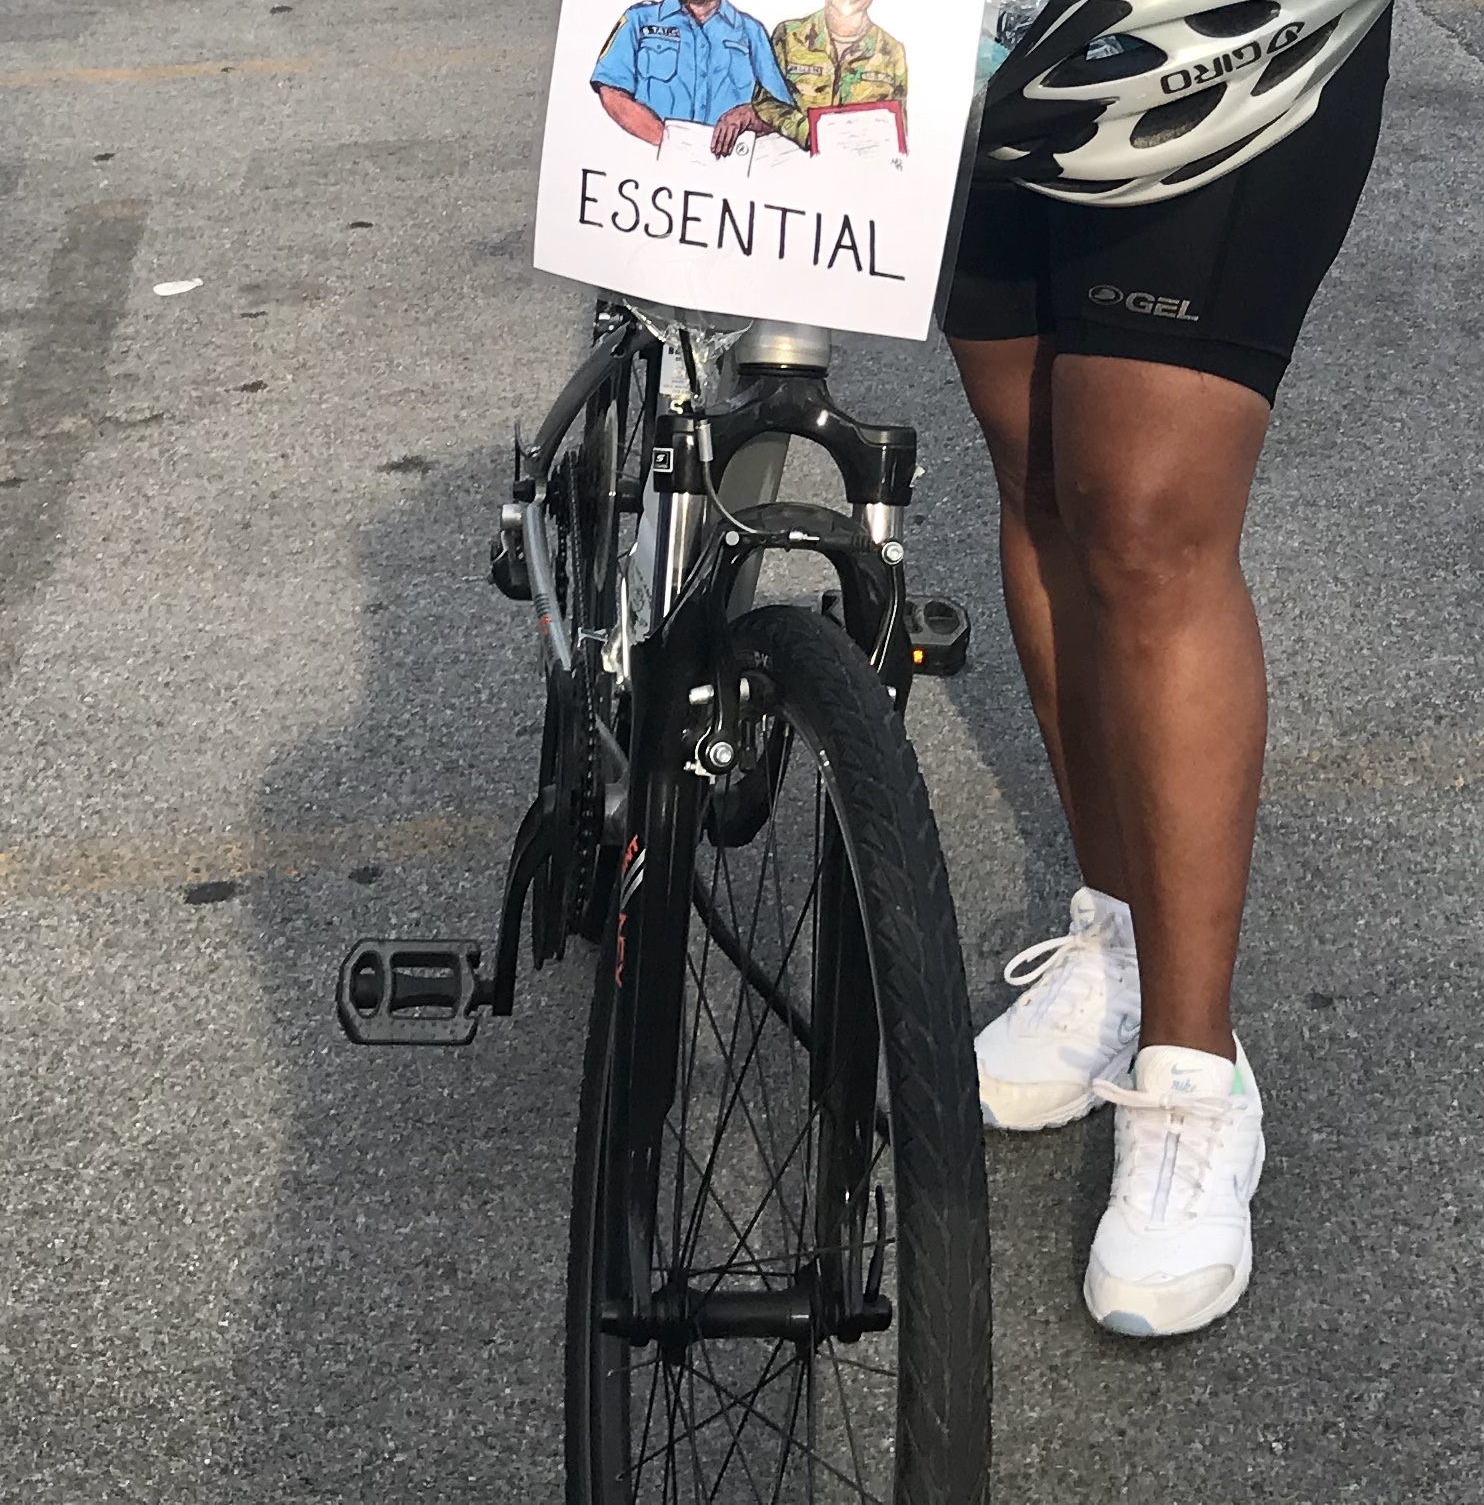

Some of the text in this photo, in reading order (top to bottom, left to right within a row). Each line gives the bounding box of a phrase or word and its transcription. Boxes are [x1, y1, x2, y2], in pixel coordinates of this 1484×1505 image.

[1160, 40, 1262, 95] GIRO
[579, 168, 907, 281] ESSENTIAL
[1125, 291, 1199, 322] GEL
